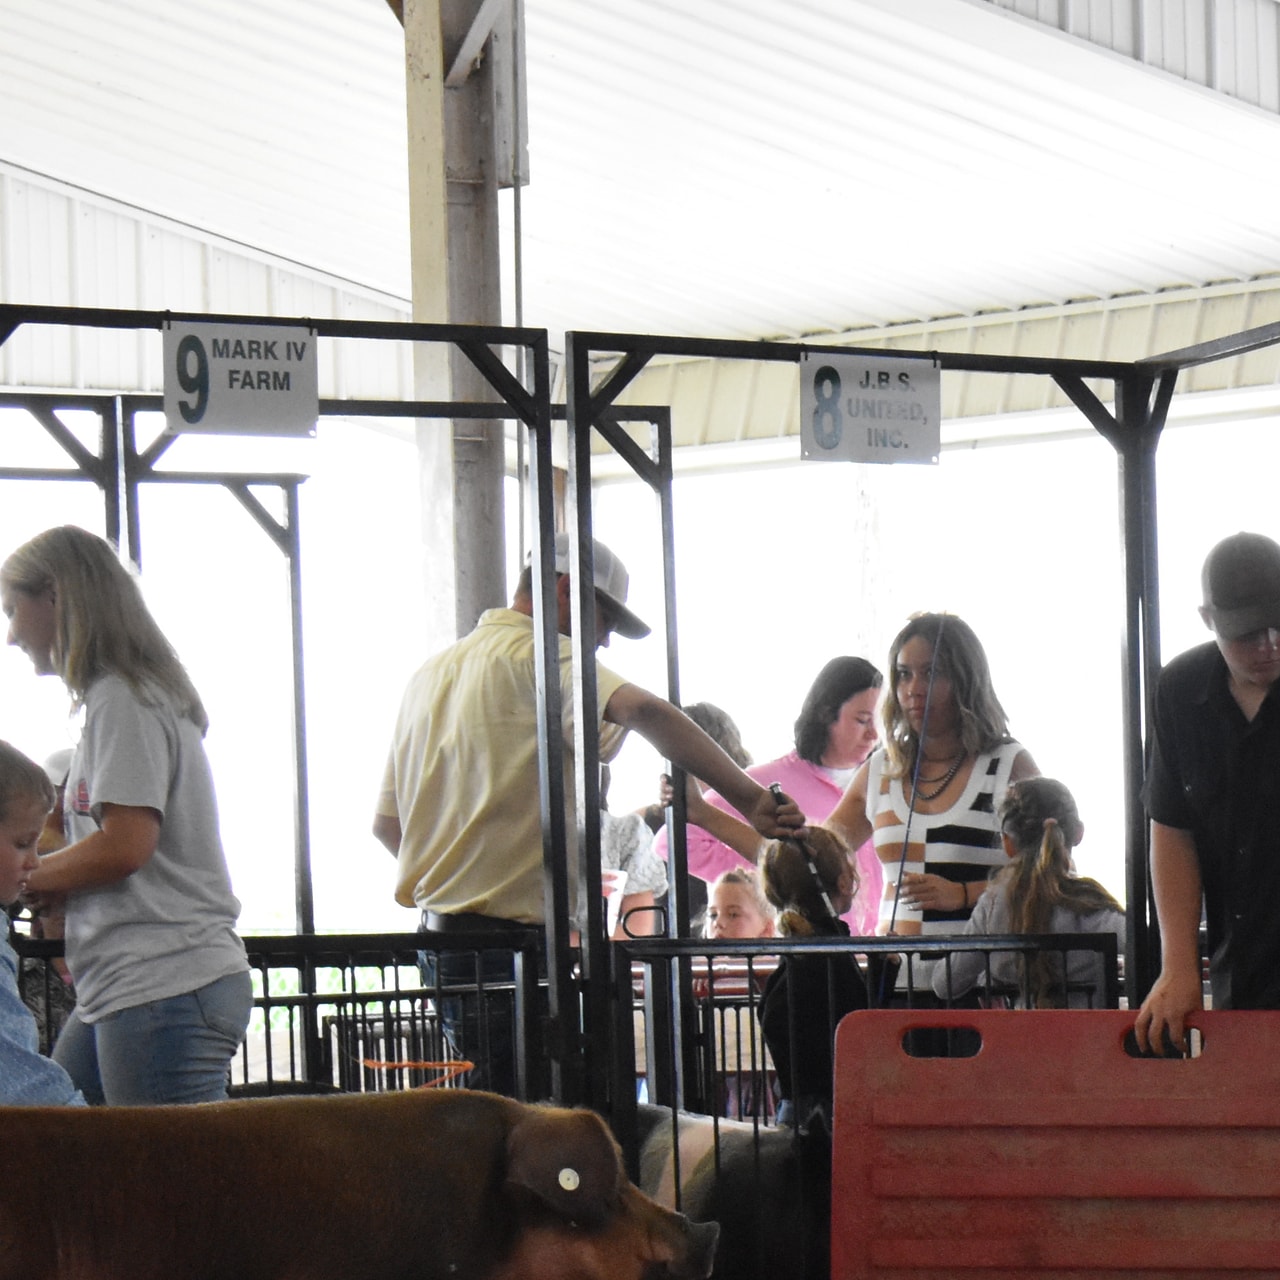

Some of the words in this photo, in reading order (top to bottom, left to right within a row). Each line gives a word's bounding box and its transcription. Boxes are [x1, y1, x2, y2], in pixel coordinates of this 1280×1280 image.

[211, 338, 279, 361] MARK
[285, 341, 307, 361] IV
[176, 334, 209, 424] 9
[228, 369, 291, 391] FARM
[813, 365, 842, 450] 8
[867, 428, 909, 449] INC.
